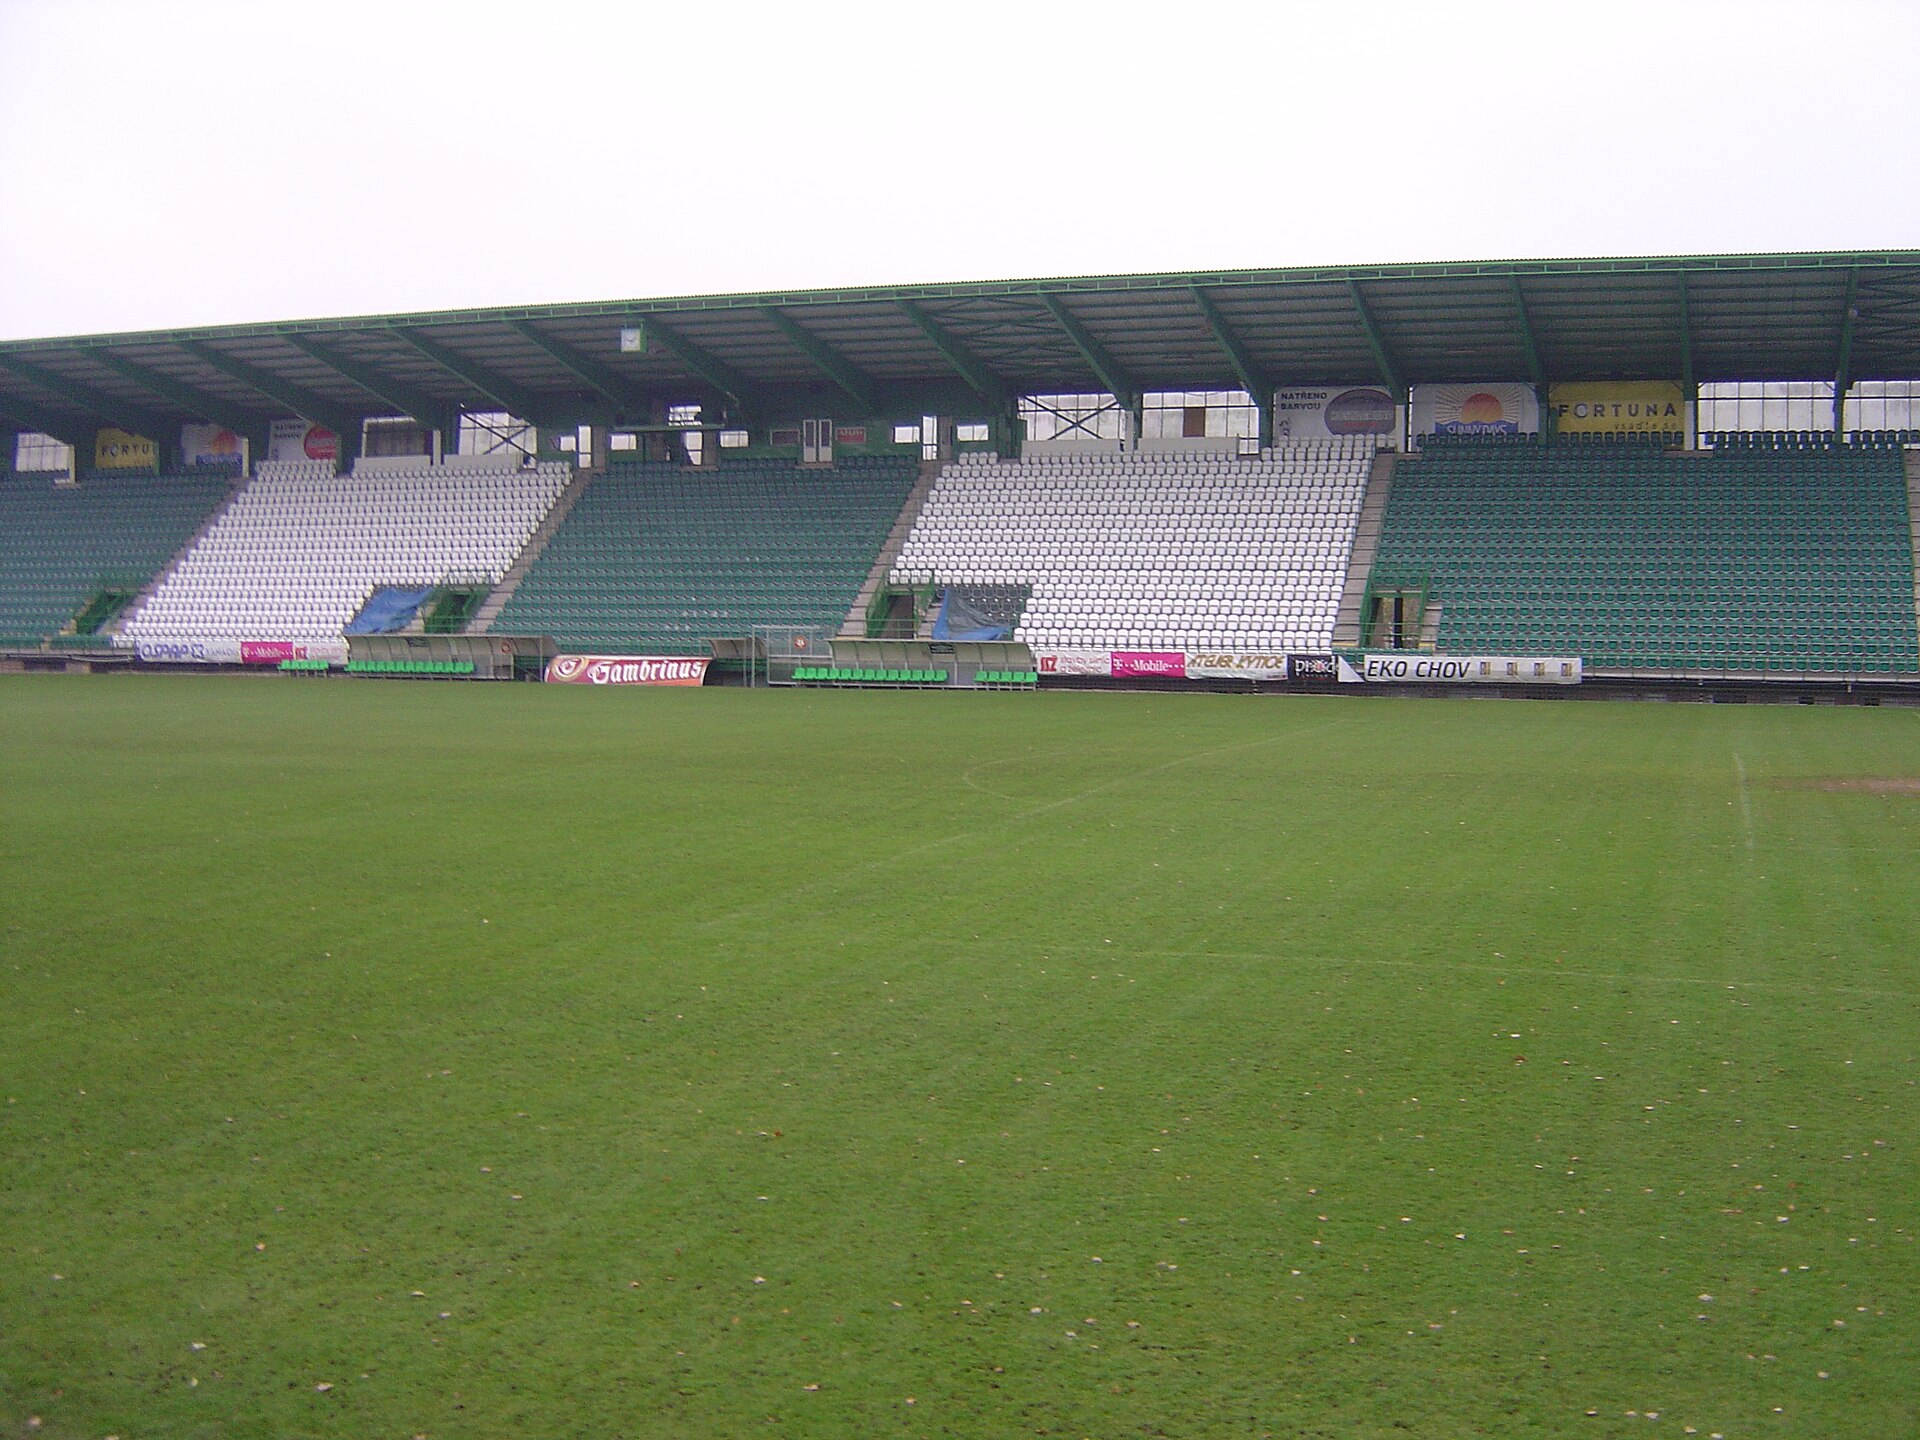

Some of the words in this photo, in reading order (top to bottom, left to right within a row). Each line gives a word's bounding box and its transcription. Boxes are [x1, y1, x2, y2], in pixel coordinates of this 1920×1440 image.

[1280, 402, 1321, 410] BARVOU
[1558, 403, 1677, 418] FORTUNA
[587, 660, 703, 684] Gambrinus
[1367, 660, 1408, 678] EKO
[1416, 661, 1471, 680] CHOV
